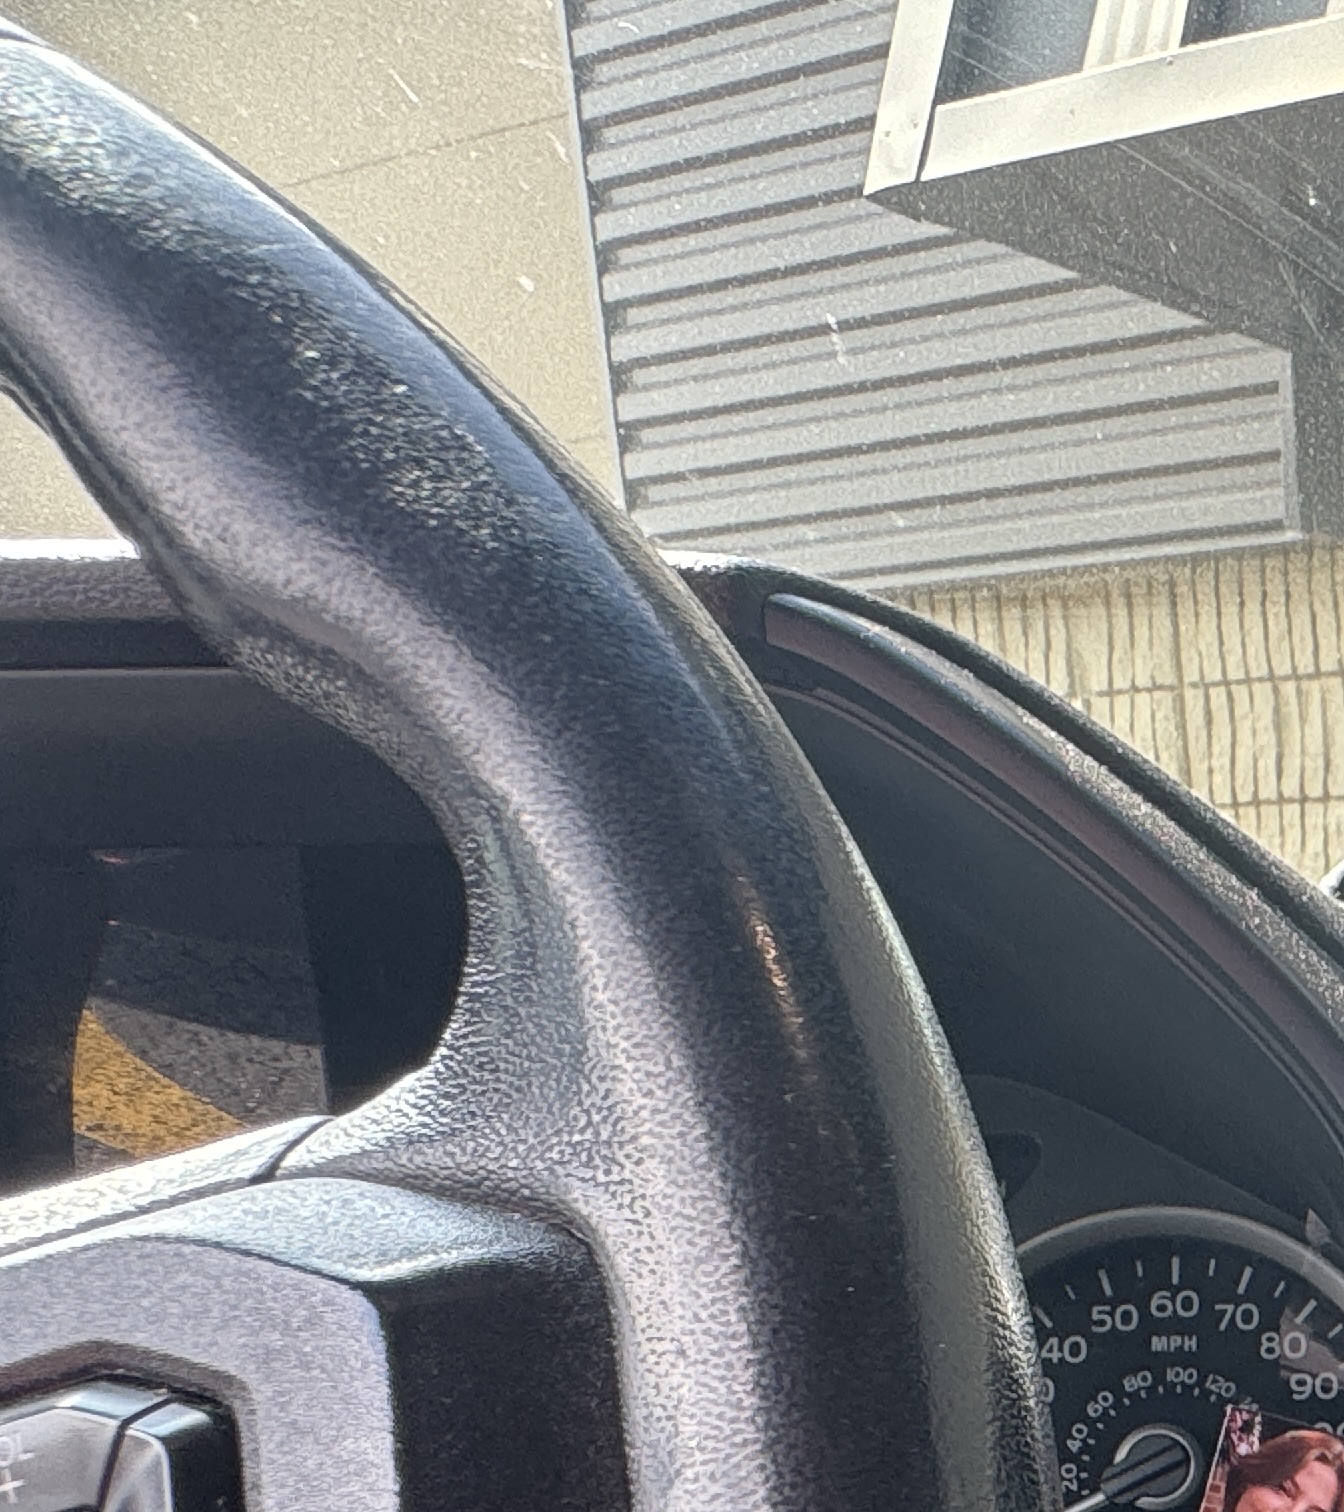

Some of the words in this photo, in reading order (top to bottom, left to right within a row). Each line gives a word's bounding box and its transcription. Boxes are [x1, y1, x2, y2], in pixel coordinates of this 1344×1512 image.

[1091, 1303, 1139, 1333] 50
[1150, 1290, 1200, 1318] 60
[1214, 1303, 1260, 1331] 70
[1040, 1335, 1088, 1364] 40
[1151, 1335, 1198, 1352] MPH
[1260, 1331, 1308, 1360] 80
[1122, 1370, 1152, 1392] 80
[1166, 1366, 1198, 1384] 100
[1205, 1373, 1236, 1398] 120
[1289, 1372, 1339, 1400] 90
[1086, 1390, 1114, 1418] 60
[1066, 1423, 1088, 1453] 40
[1061, 1463, 1078, 1492] 20
